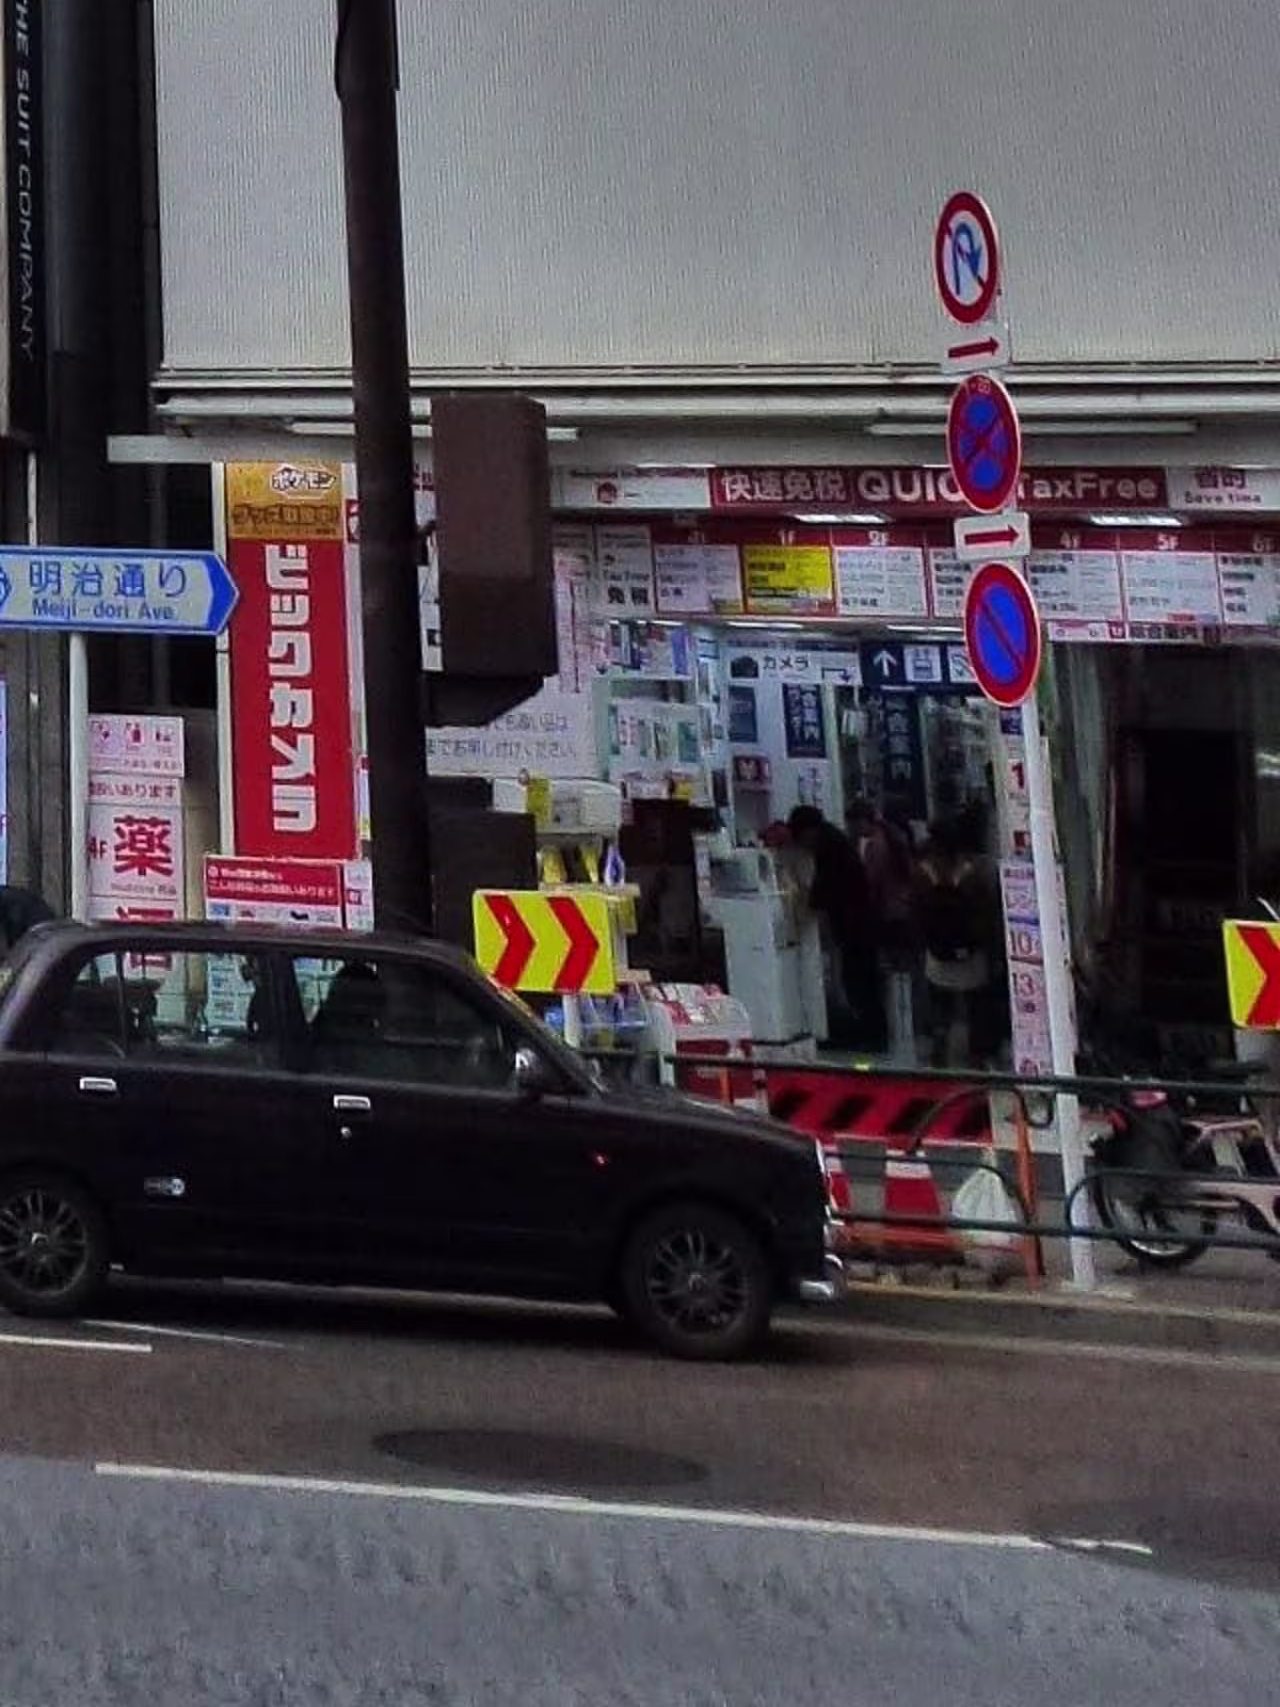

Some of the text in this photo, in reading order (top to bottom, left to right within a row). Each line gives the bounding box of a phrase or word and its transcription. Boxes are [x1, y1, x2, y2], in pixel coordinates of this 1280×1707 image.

[16, 72, 31, 149] SUIT
[18, 165, 35, 363] COMPANY
[272, 467, 337, 490] ポケモン
[1018, 471, 1157, 502] TaxFree
[28, 560, 188, 599] 明治通り
[32, 598, 131, 620] Meiji-dori
[762, 655, 810, 671] カメラ
[266, 543, 320, 834] ビックカメラ
[113, 814, 174, 877] 薬
